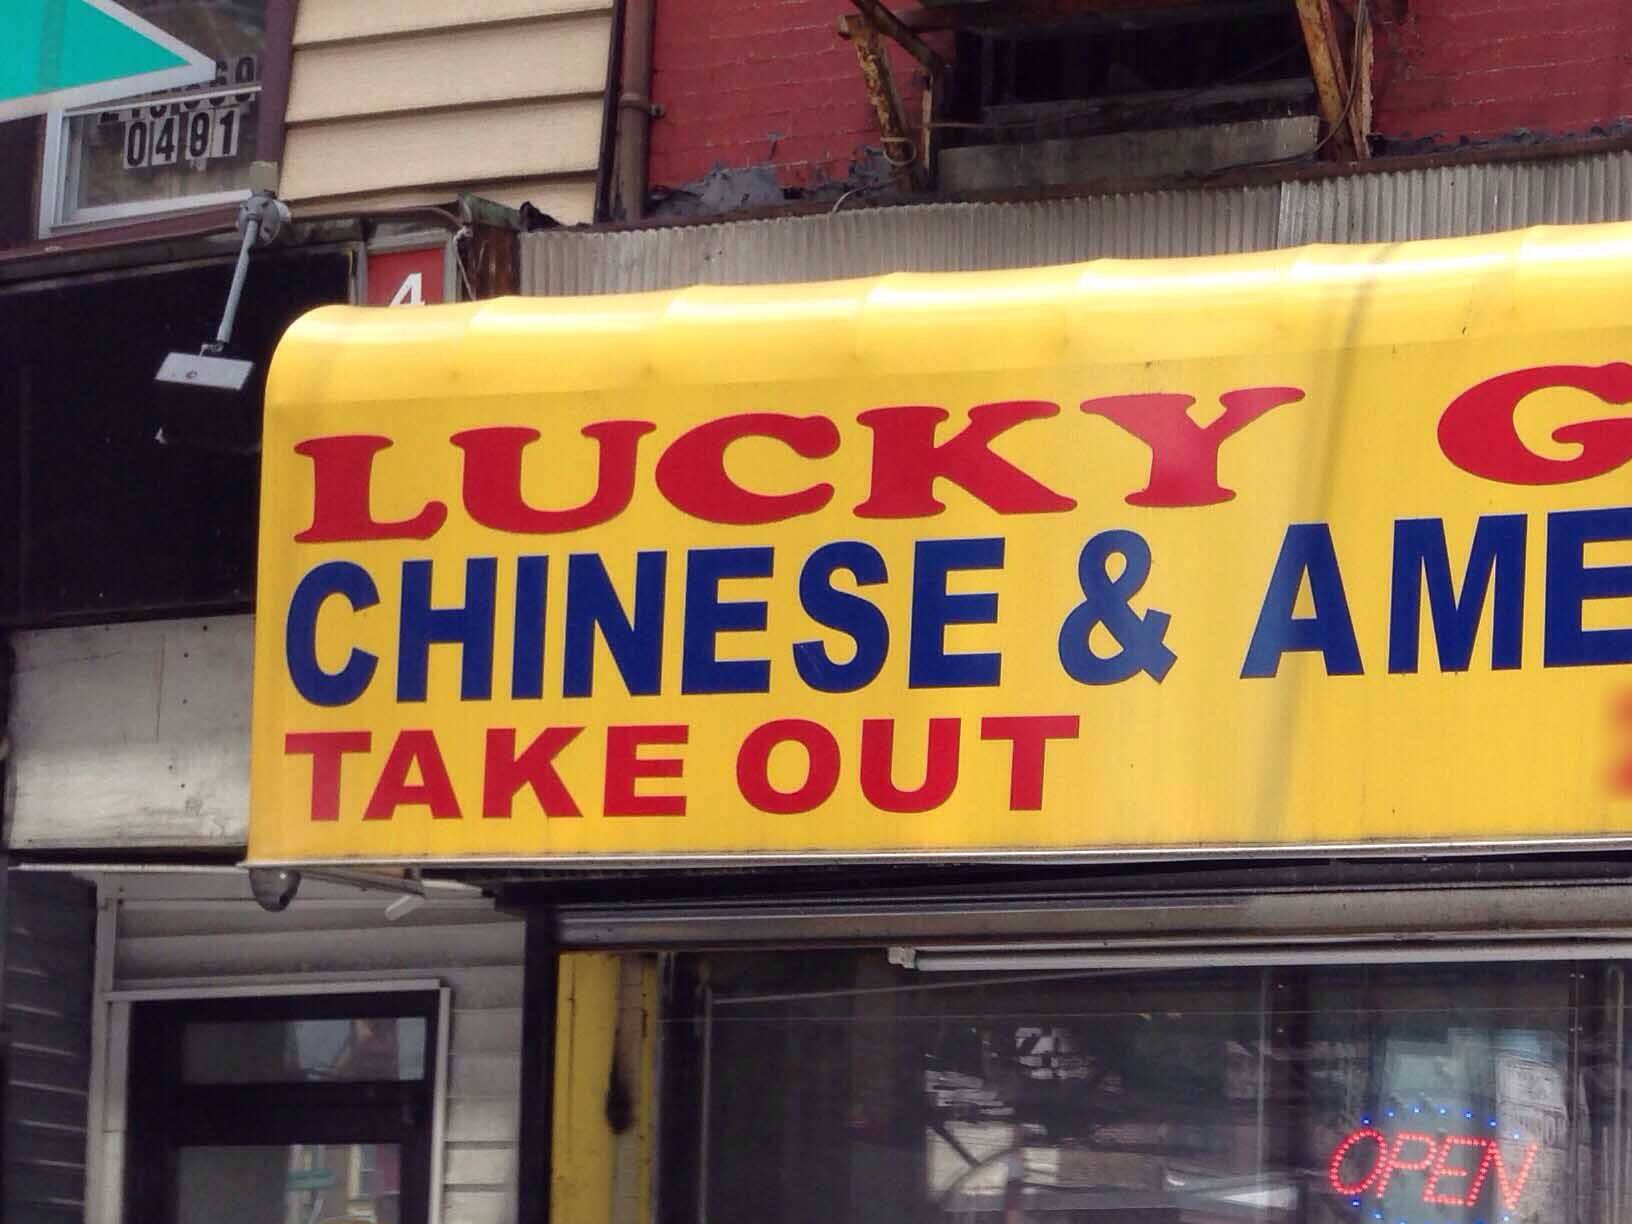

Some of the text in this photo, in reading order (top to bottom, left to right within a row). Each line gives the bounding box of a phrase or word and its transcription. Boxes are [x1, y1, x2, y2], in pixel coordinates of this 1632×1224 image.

[293, 386, 1306, 544] LUCKY
[285, 536, 1006, 707] CHINESE
[1057, 529, 1178, 686] &
[284, 714, 1081, 822] TAKE OUT
[1328, 1127, 1538, 1212] OPEN
